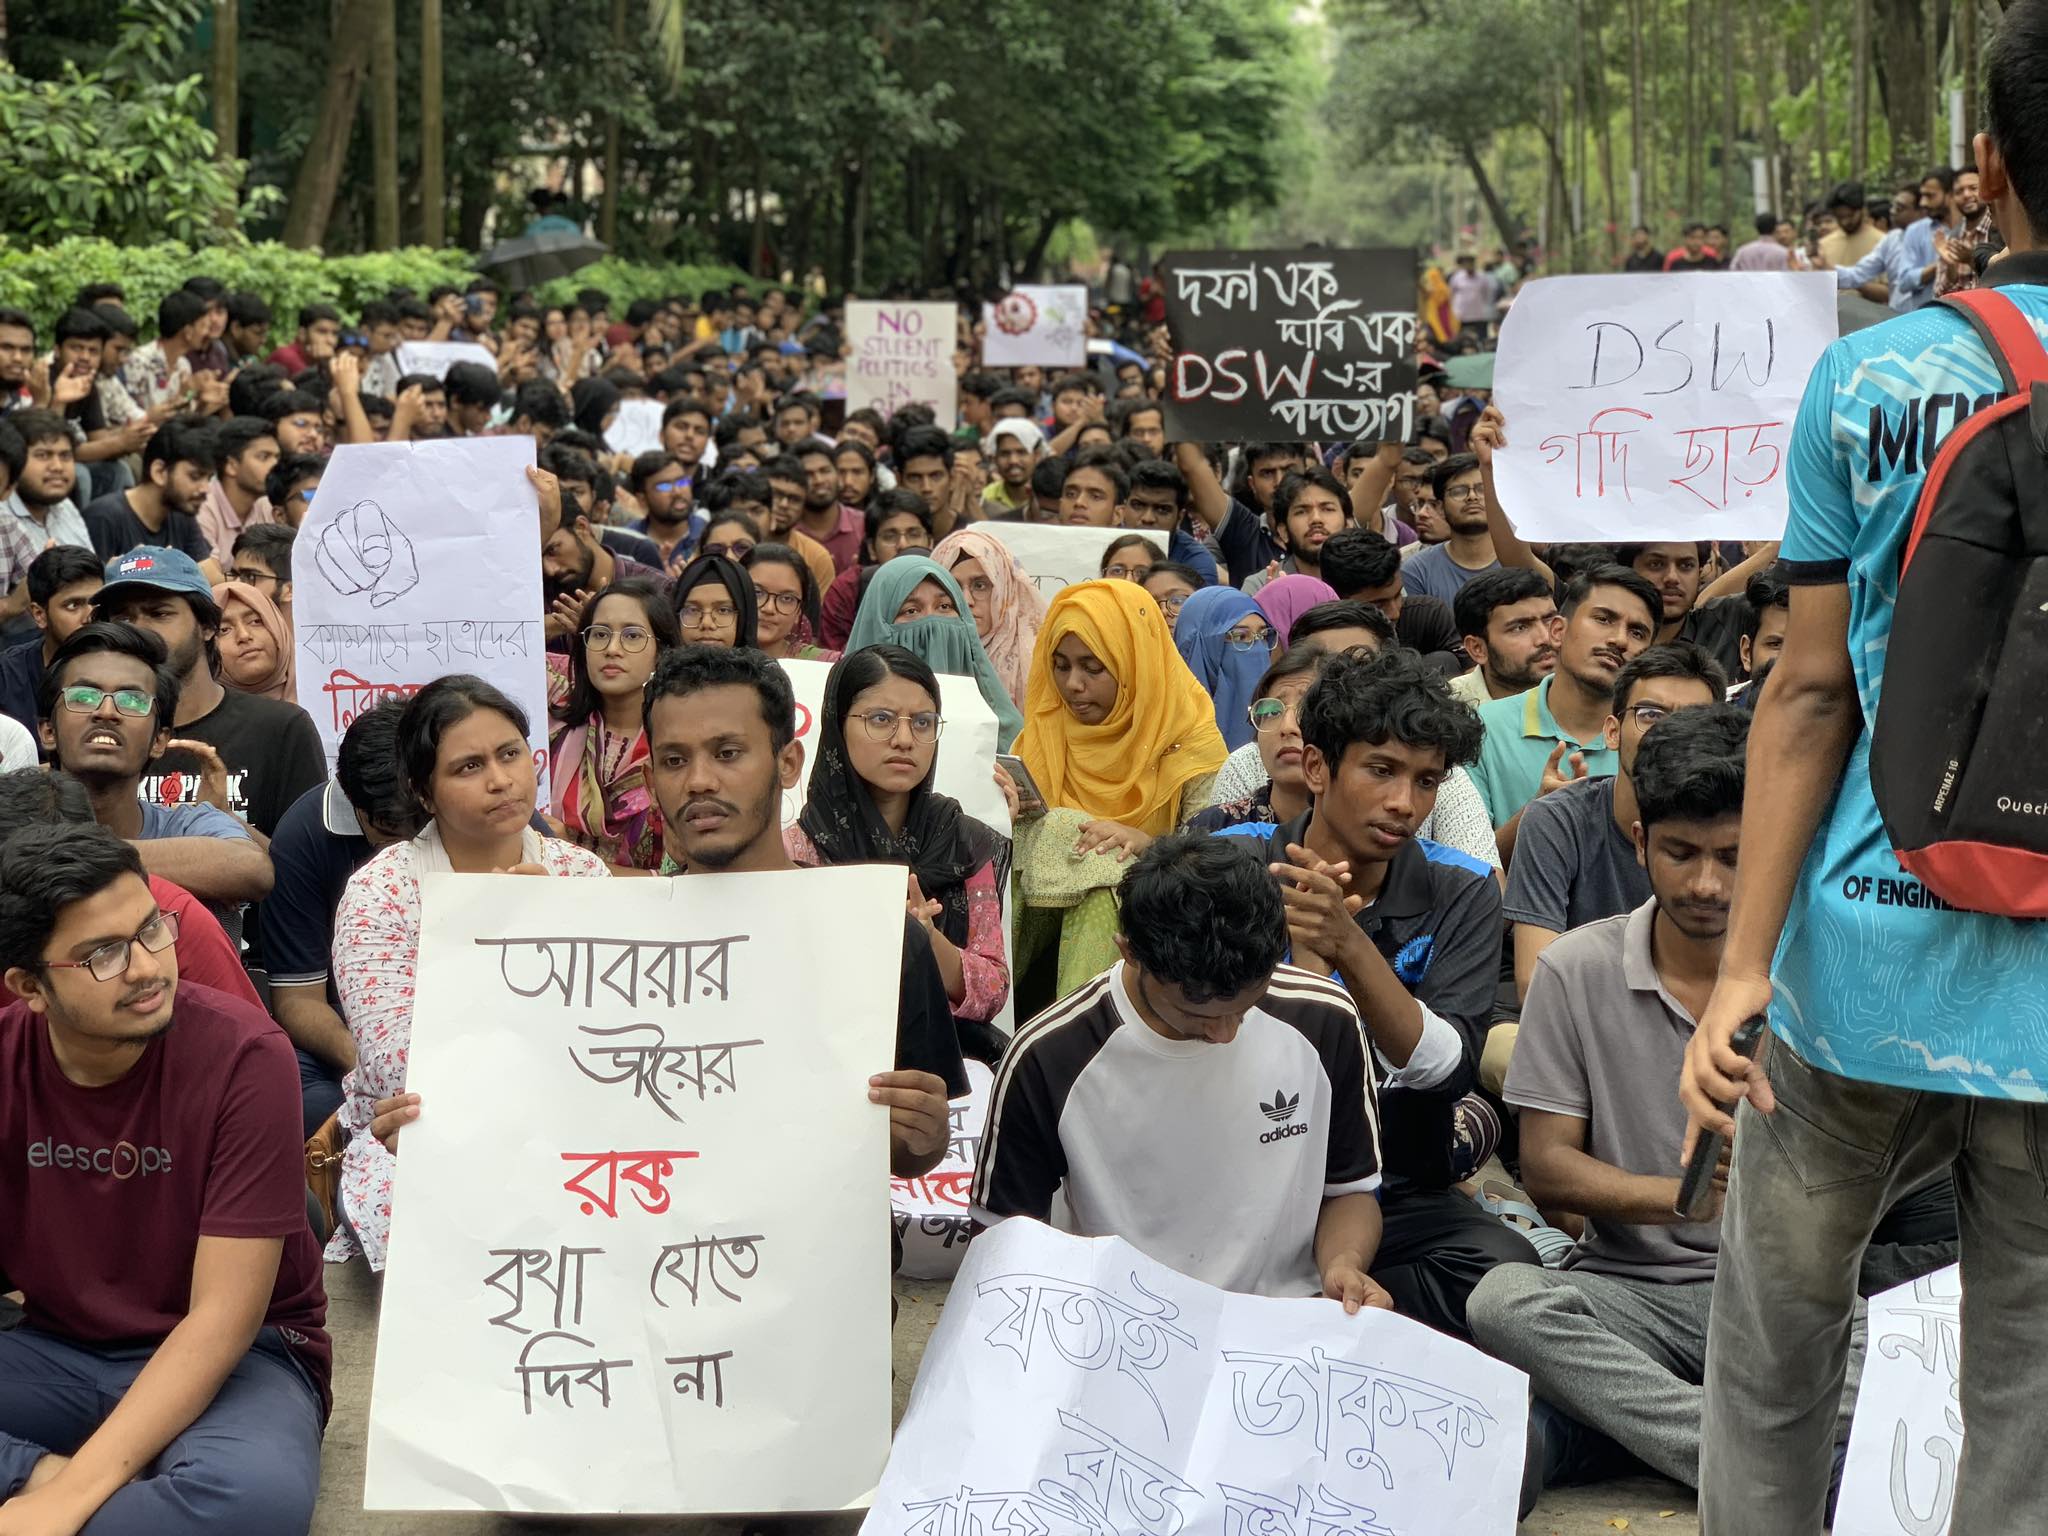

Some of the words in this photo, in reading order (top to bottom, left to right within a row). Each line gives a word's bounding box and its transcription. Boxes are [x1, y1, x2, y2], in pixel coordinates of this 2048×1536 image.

[1173, 261, 1258, 317] দফা
[1263, 262, 1339, 312] এক
[877, 309, 923, 336] NO
[1275, 299, 1363, 352] দাবি
[1348, 311, 1418, 359] এক
[857, 357, 938, 379] POLITICS
[1173, 349, 1318, 404] DSW
[1321, 361, 1393, 394] এর
[1568, 317, 1775, 396] DSW
[1270, 390, 1418, 443] পদত্যাগ
[1539, 407, 1654, 505] গদি
[1668, 421, 1785, 511] ছাড়
[300, 622, 410, 673] ক্যাম্পাসে
[1933, 771, 1956, 813] ARPENAZ
[1842, 874, 1873, 903] OF
[474, 934, 751, 1008] আবরার
[567, 1022, 765, 1125] ভাইয়ের
[1259, 1122, 1308, 1144] adidas
[560, 1150, 700, 1219] রক্ত
[482, 1244, 607, 1335] বৃথা
[650, 1234, 766, 1308] যেতে
[513, 1330, 634, 1416] দিব
[664, 1350, 734, 1409] না
[975, 1270, 1199, 1443] যতই
[1221, 1346, 1501, 1491] ডাকুক
